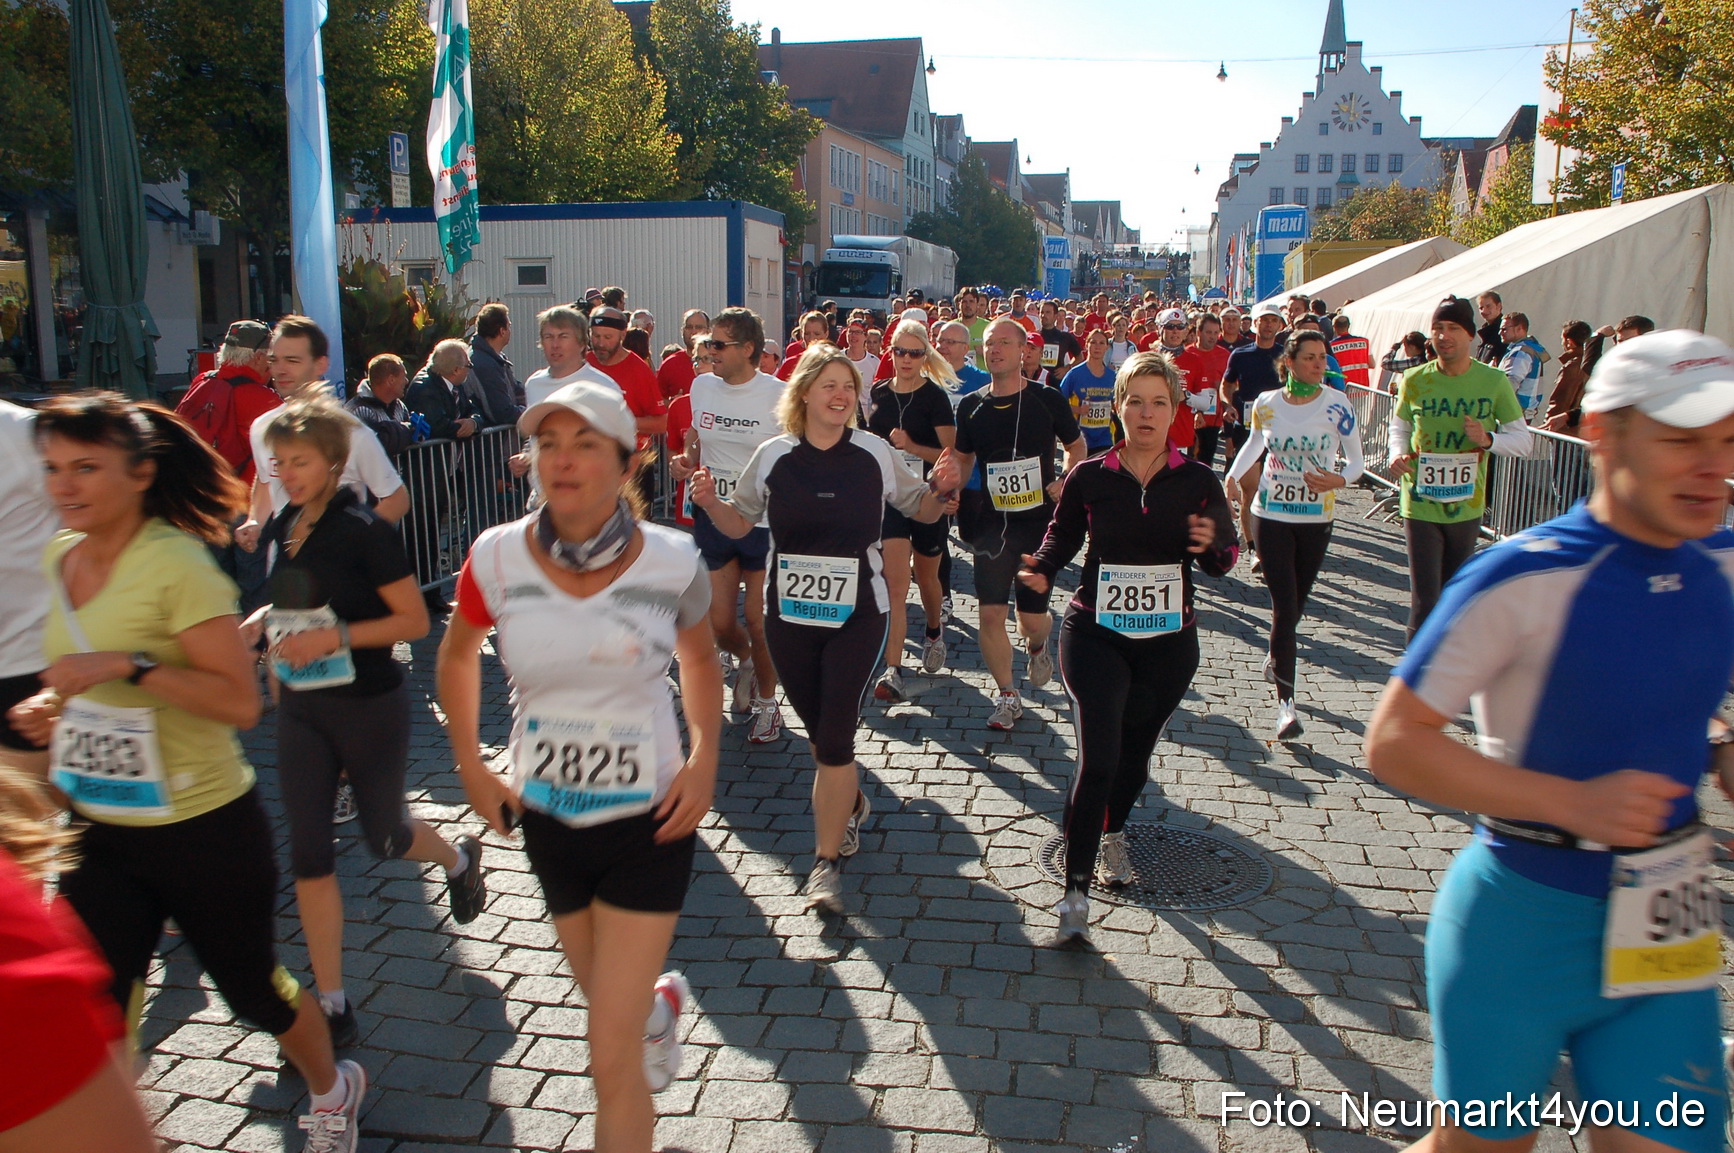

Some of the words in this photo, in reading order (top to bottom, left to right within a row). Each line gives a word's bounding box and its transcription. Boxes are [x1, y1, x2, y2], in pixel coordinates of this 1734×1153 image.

[1267, 213, 1303, 233] maxi
[1052, 260, 1063, 268] dsl
[1422, 397, 1494, 419] HAND
[715, 415, 760, 428] Egner
[1434, 431, 1467, 450] IN
[998, 472, 1031, 495] 381
[1424, 465, 1472, 486] 3116
[998, 490, 1036, 506] Michael
[1273, 483, 1319, 503] 2615
[1424, 485, 1469, 498] Christian
[1282, 502, 1308, 514] Karin
[1110, 571, 1147, 580] PFLEIDERER
[786, 572, 848, 602] 2297
[1106, 583, 1170, 612] 2851
[793, 600, 838, 619] Regina
[1112, 613, 1167, 629] Claudia
[531, 740, 640, 786] 2825
